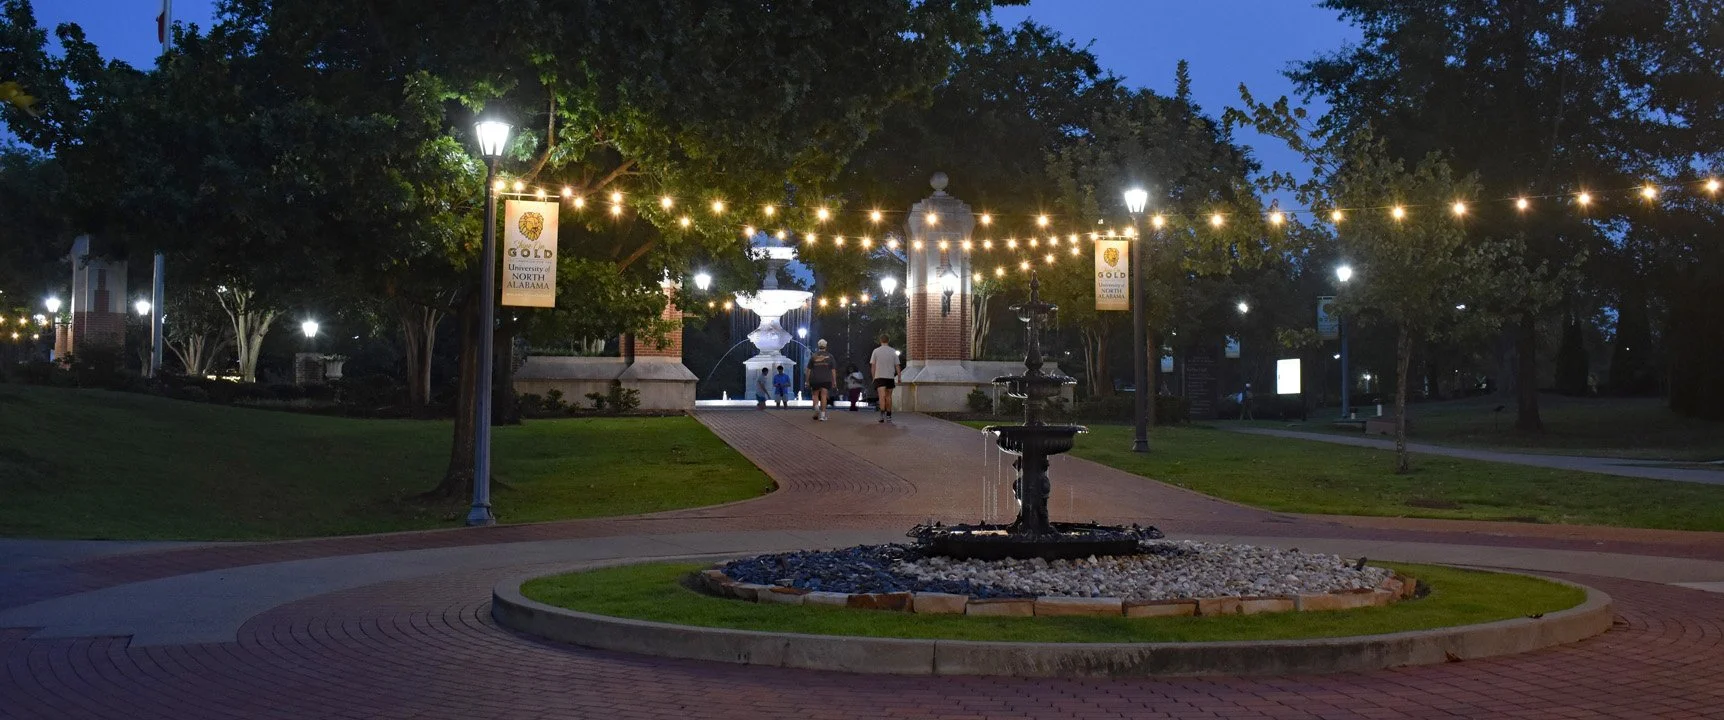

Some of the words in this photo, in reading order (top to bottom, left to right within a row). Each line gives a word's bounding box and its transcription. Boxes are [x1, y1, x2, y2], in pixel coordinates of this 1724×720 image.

[508, 248, 552, 259] GOLD
[508, 264, 544, 273] University
[512, 273, 544, 281] NORTH
[506, 281, 550, 290] ALABAMA
